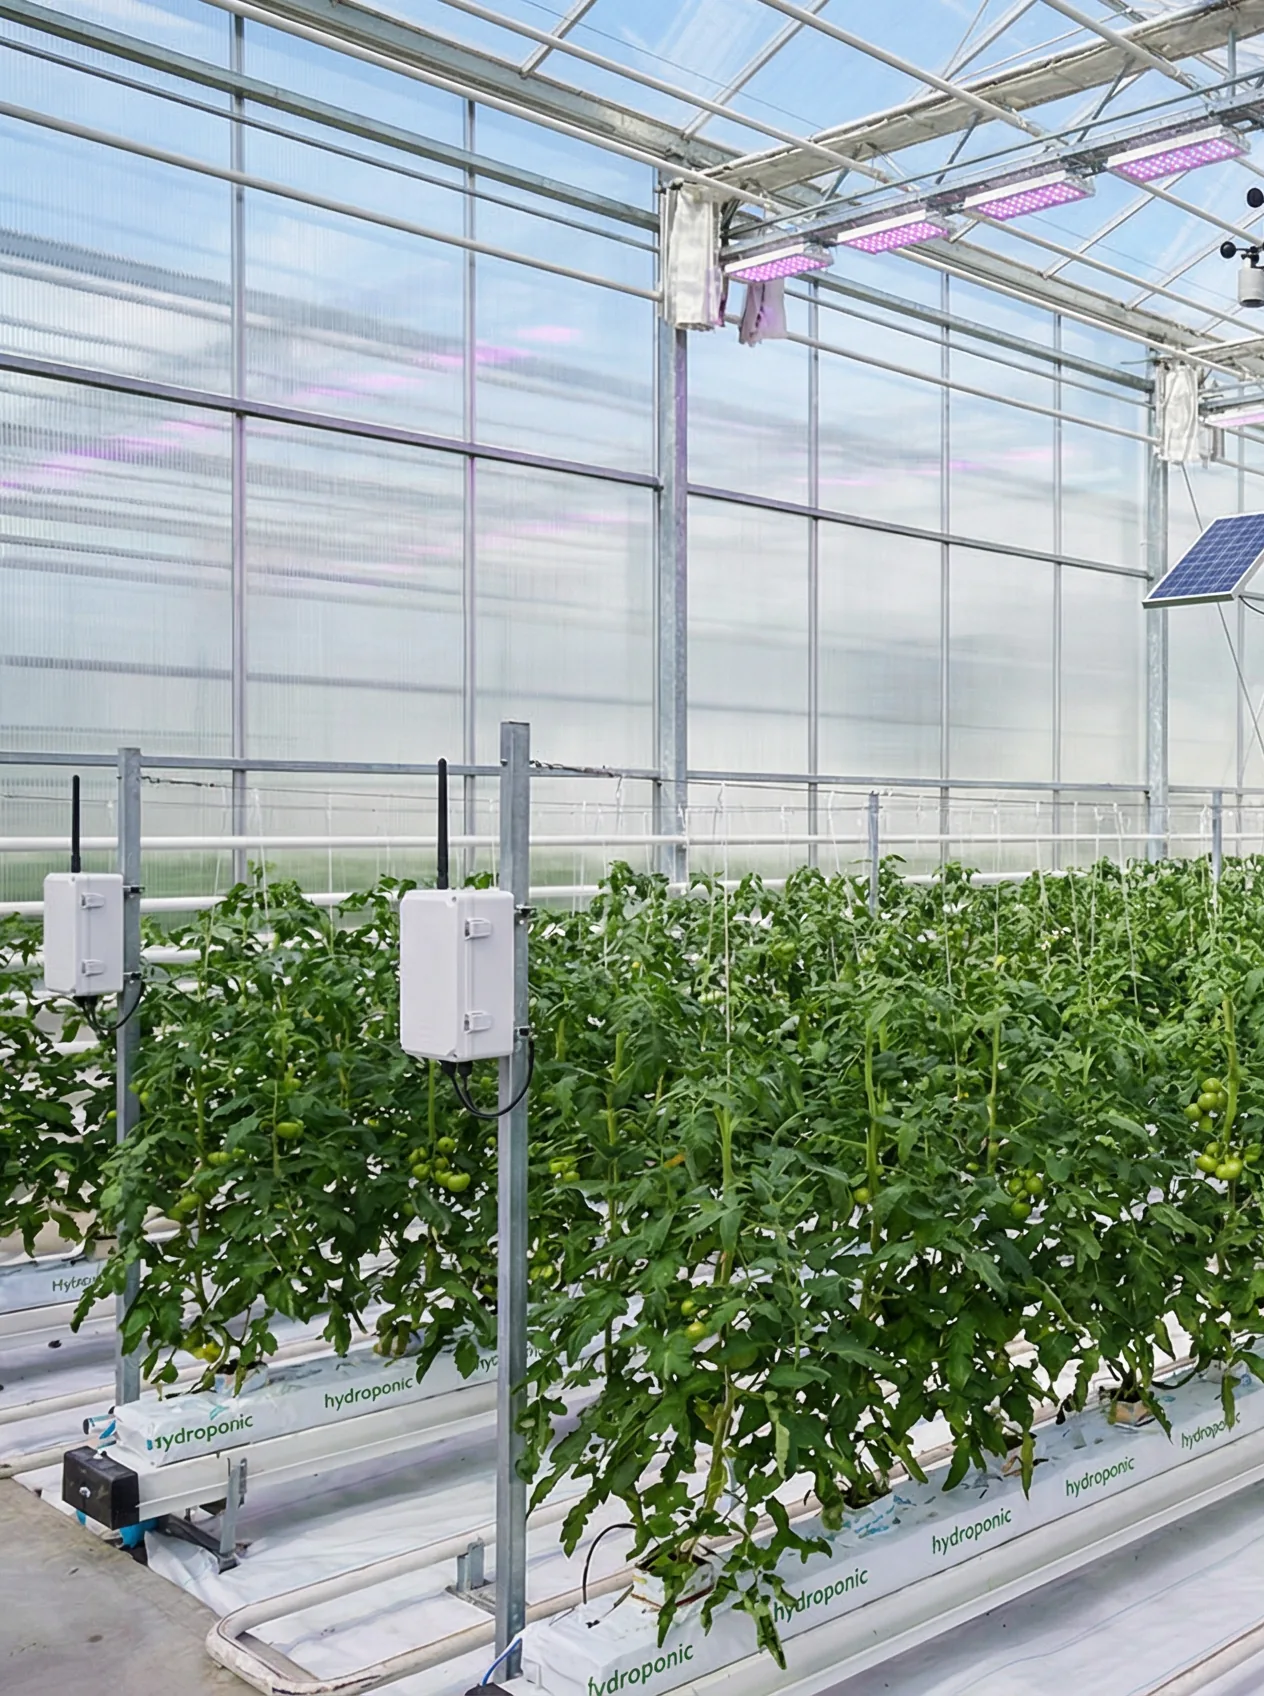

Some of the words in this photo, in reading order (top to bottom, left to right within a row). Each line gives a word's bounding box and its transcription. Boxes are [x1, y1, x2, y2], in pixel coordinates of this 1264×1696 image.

[324, 1377, 413, 1411] hydroponic
[1181, 1412, 1241, 1450] hydropoc
[1065, 1456, 1135, 1498] hydroponic
[932, 1508, 1012, 1556] hydroponic
[774, 1568, 869, 1623] hydroponic
